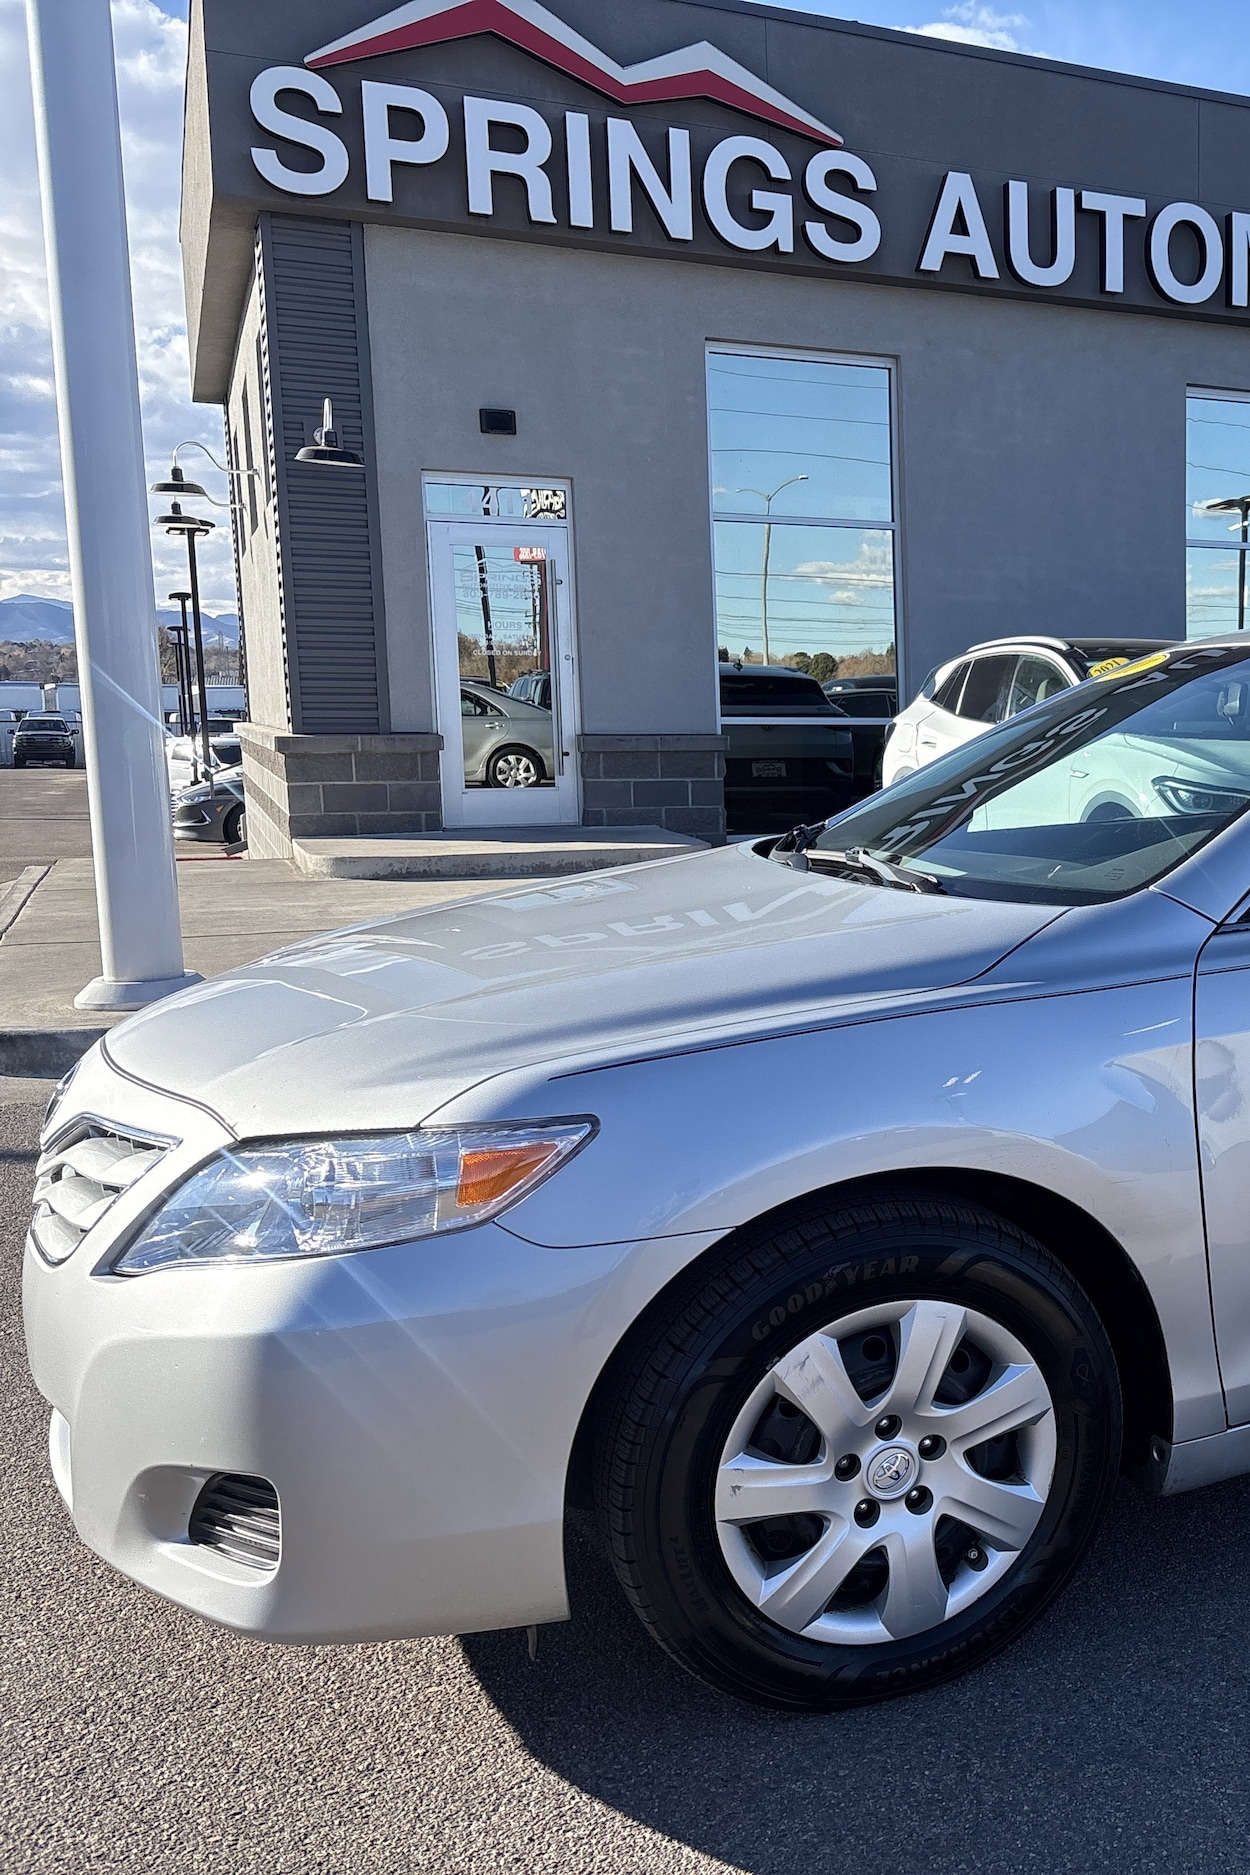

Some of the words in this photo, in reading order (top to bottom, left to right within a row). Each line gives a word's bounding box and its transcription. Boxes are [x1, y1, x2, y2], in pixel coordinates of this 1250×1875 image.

[248, 65, 882, 263] SPRINGS
[488, 620, 523, 629] HOURS
[750, 1254, 921, 1341] GOODYEAR
